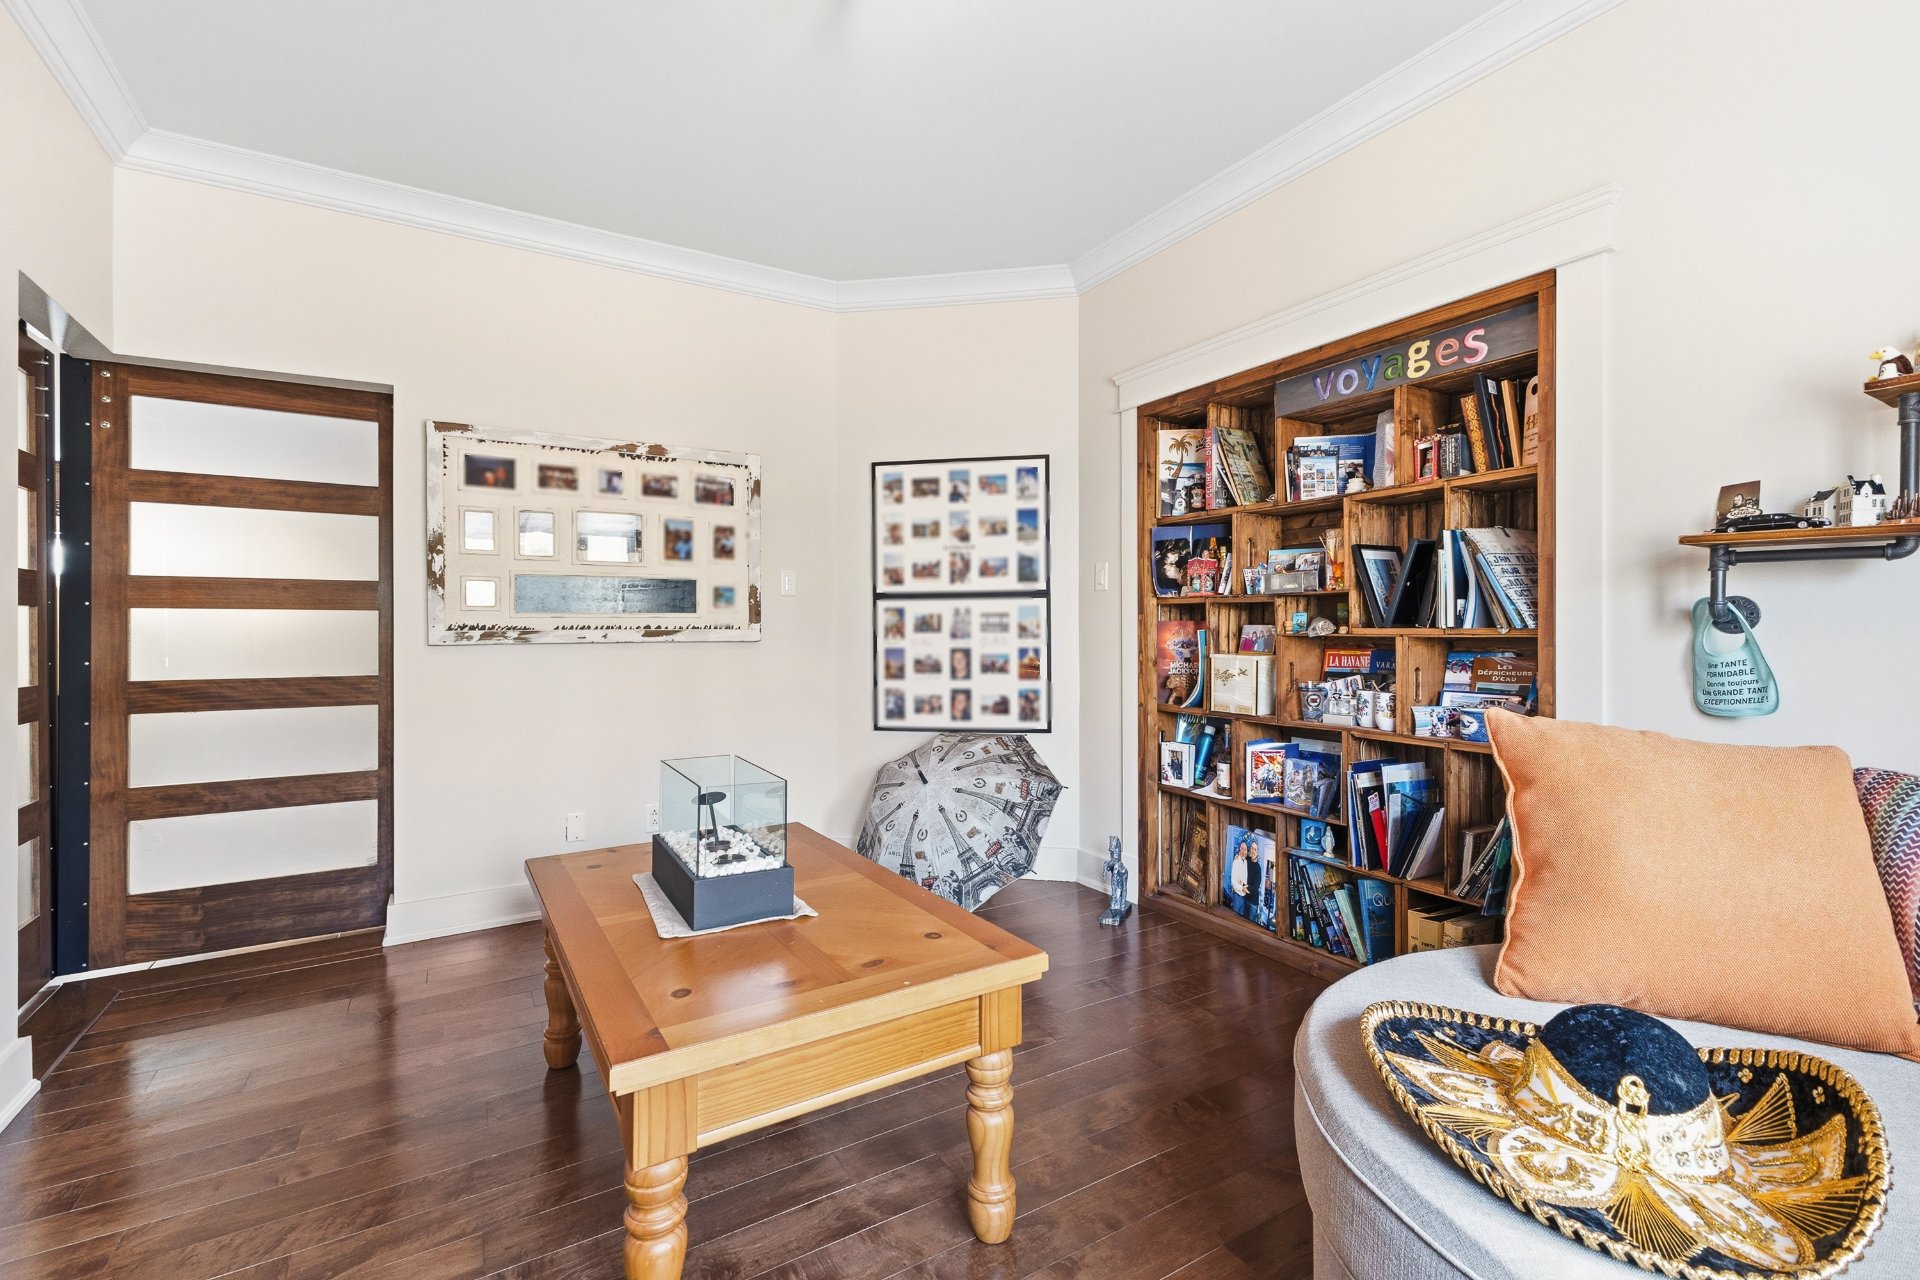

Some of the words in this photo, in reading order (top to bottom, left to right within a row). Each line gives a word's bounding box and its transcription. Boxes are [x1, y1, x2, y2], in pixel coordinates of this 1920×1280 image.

[1312, 327, 1488, 400] voyages
[1169, 660, 1199, 669] MICHAE
[1329, 656, 1339, 667] LA
[1341, 656, 1370, 667] HAVANE
[1720, 659, 1748, 668] TANTE
[1707, 668, 1755, 678] FORMIDABLE
[1728, 679, 1759, 687] toujours
[1747, 686, 1768, 694] TANTE
